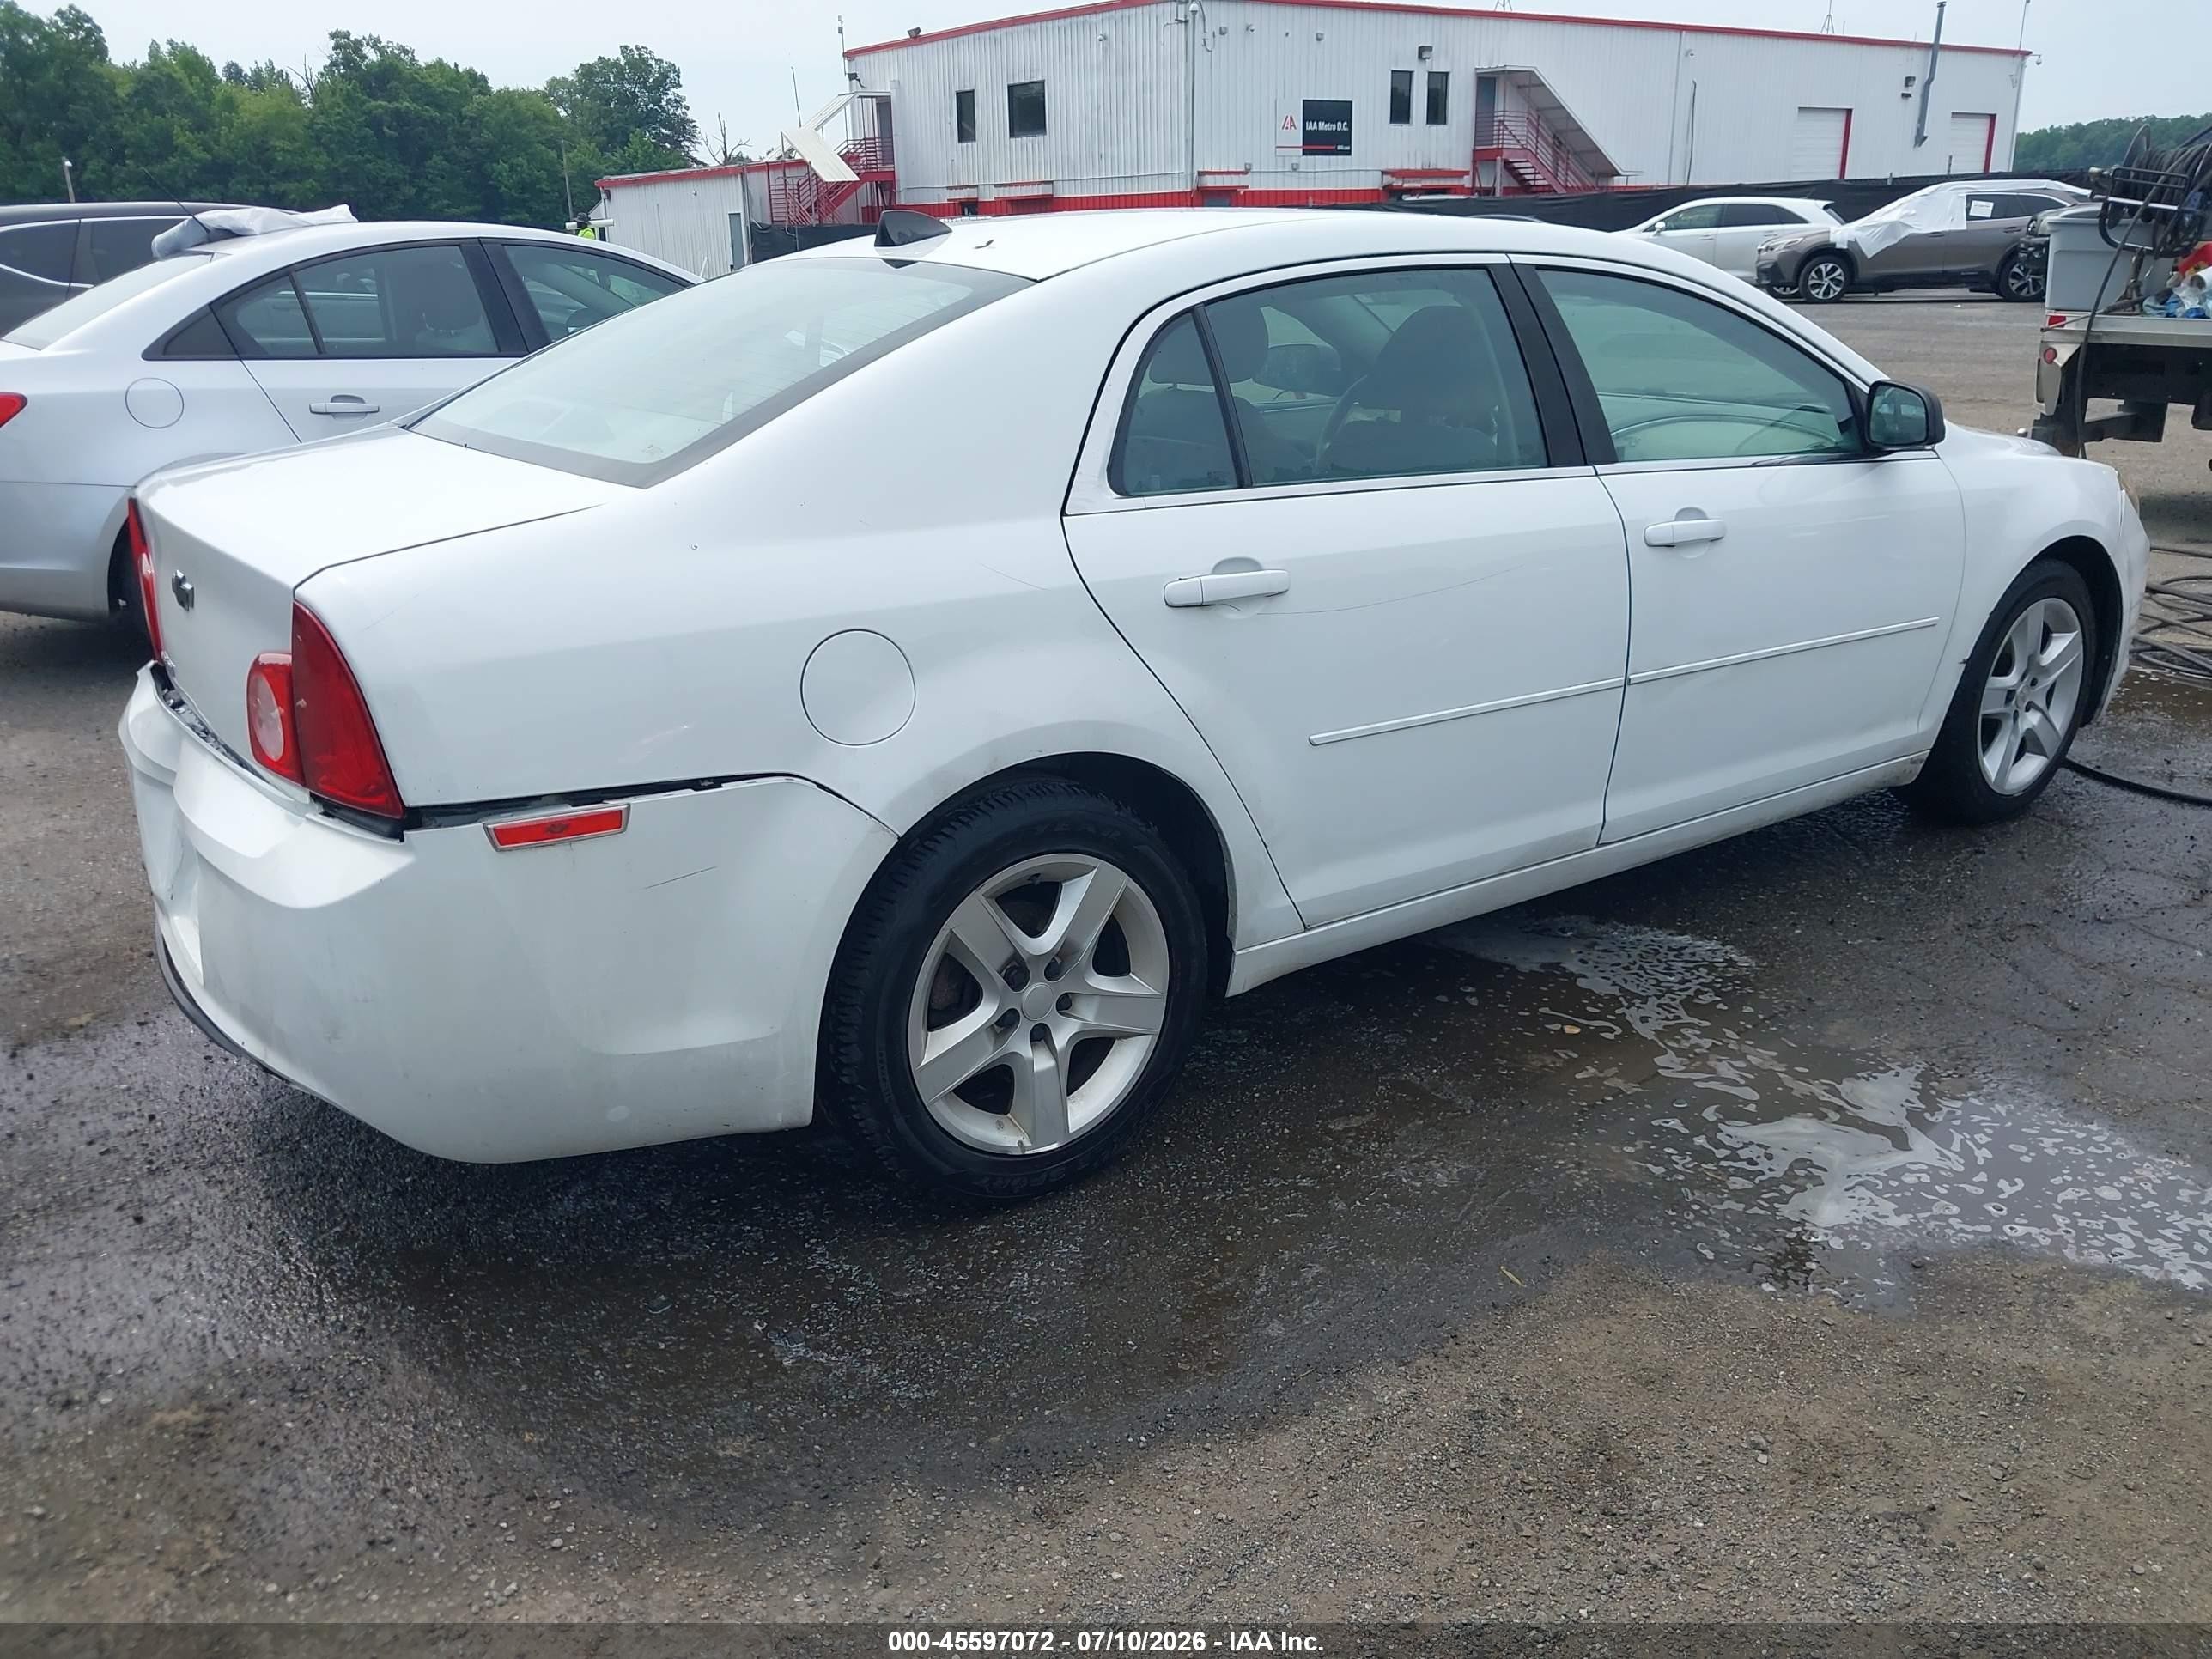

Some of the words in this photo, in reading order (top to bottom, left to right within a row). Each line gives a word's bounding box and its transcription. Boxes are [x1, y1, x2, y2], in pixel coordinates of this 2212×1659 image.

[1305, 121, 1318, 131] IAA
[1318, 121, 1336, 131] Metro
[1337, 121, 1349, 131] D.C.
